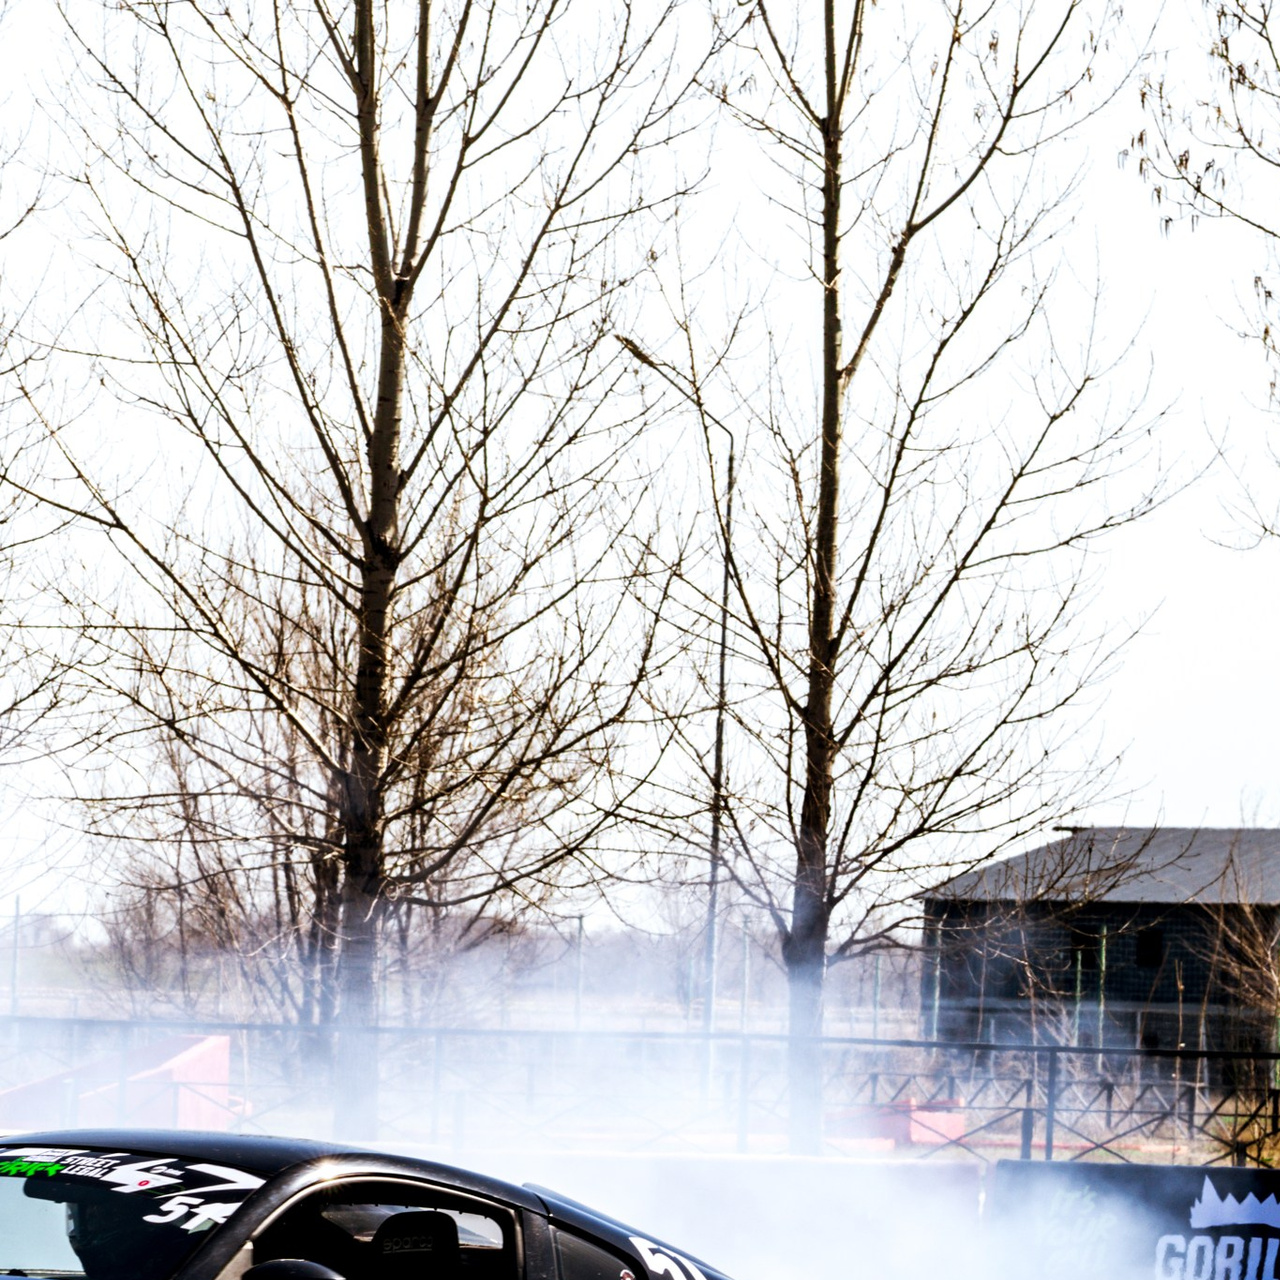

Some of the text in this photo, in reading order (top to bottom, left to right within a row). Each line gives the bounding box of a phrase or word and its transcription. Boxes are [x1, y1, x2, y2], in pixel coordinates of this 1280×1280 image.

[60, 1156, 120, 1168] STREET
[60, 1165, 109, 1178] LEGAL
[383, 1235, 433, 1254] sparco
